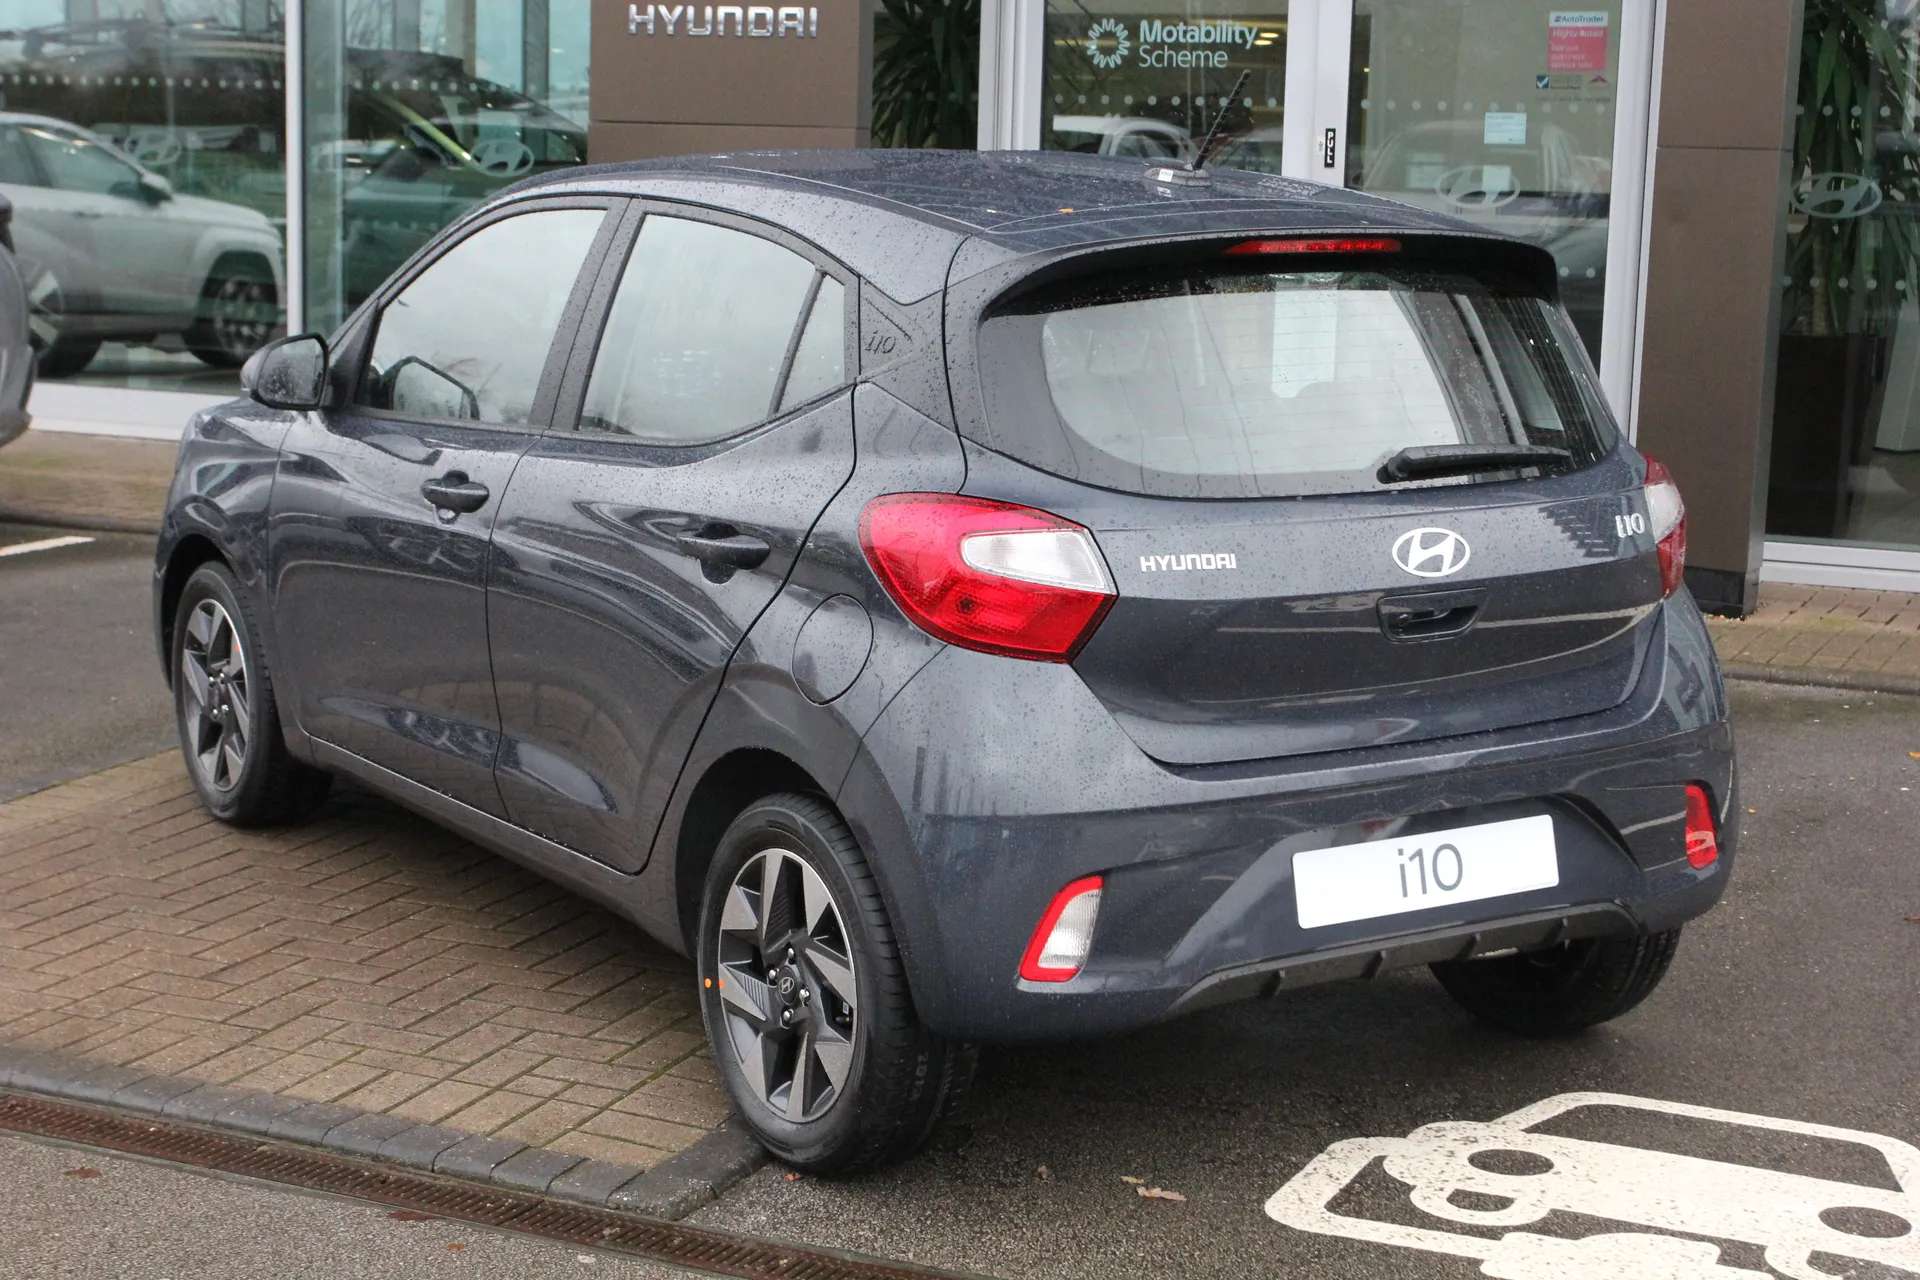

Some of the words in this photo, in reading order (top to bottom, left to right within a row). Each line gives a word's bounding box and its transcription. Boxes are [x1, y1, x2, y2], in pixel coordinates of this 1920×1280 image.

[628, 4, 818, 37] HYUNDAI
[1139, 19, 1258, 49] Motability
[1139, 45, 1228, 68] Scheme
[864, 329, 897, 355] i10
[1614, 512, 1646, 538] i10
[1140, 553, 1237, 572] HYUNDAI
[1397, 843, 1464, 898] i10
